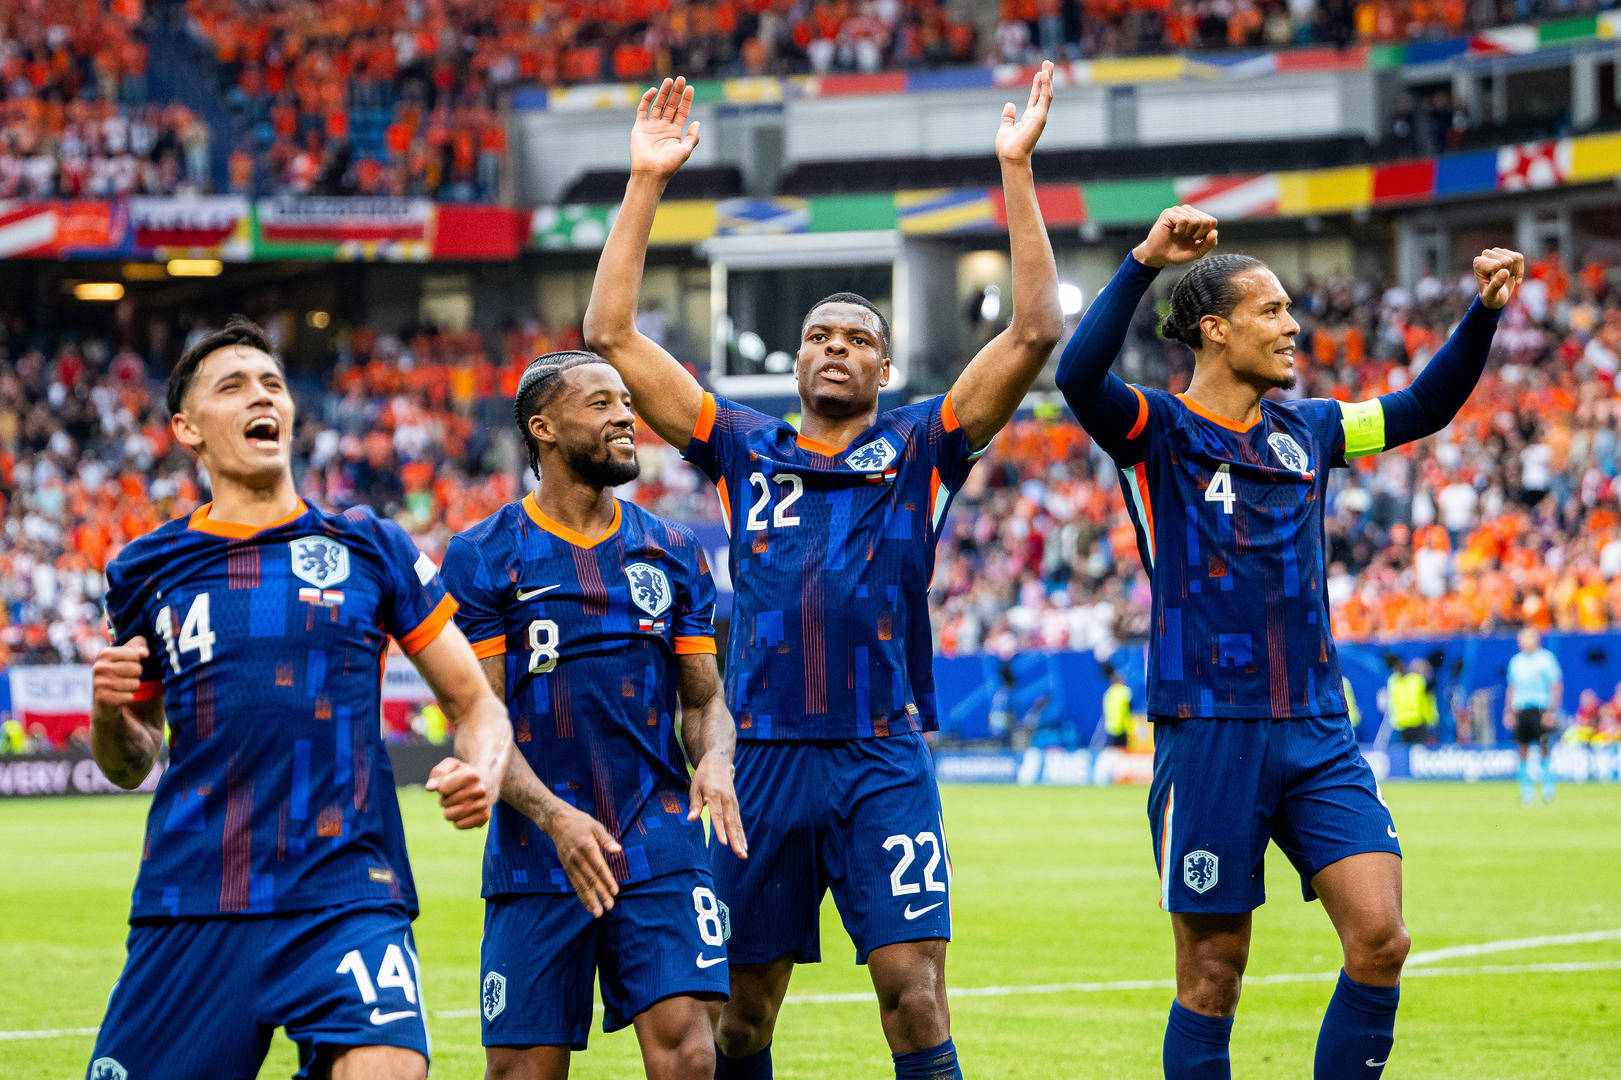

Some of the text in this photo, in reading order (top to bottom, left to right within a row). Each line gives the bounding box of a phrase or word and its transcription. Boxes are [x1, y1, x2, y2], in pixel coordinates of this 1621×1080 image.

[746, 472, 803, 531] 22
[1204, 463, 1236, 514] 4
[155, 592, 216, 674] 14
[528, 619, 560, 673] 8
[882, 831, 946, 896] 22
[692, 886, 723, 946] 8
[335, 943, 417, 1005] 14
